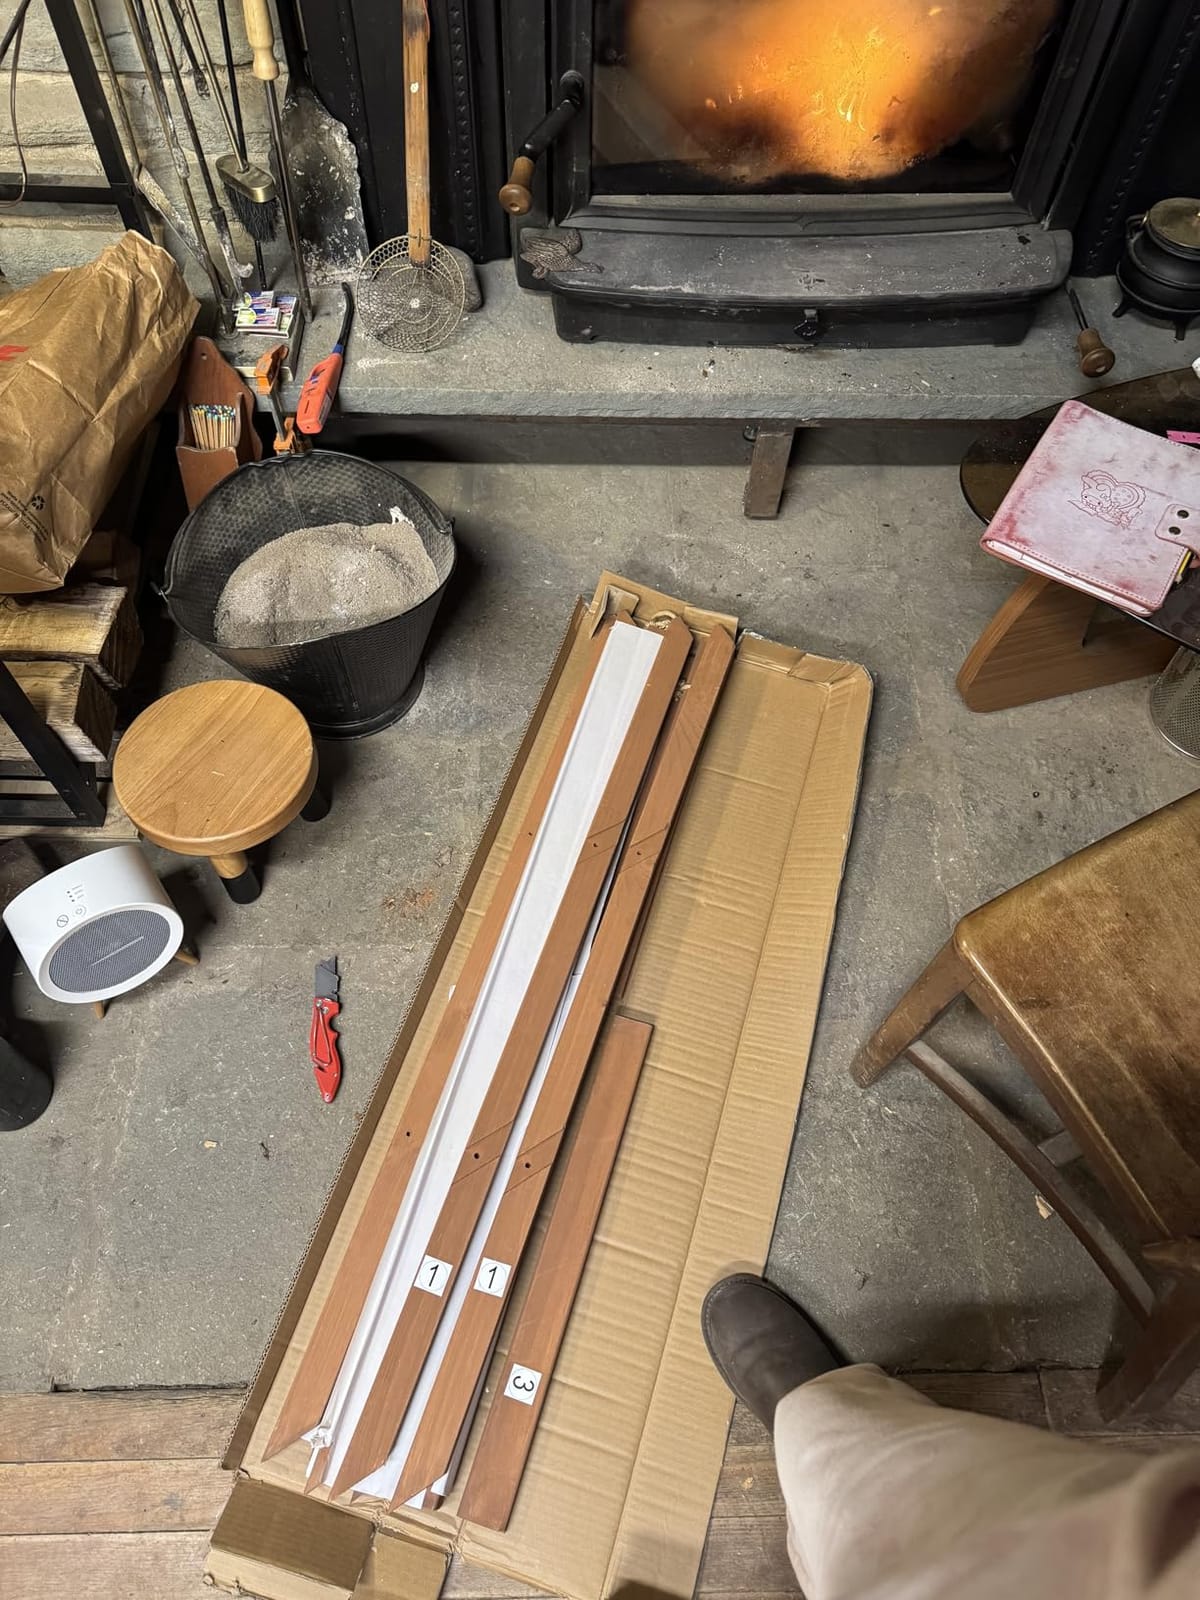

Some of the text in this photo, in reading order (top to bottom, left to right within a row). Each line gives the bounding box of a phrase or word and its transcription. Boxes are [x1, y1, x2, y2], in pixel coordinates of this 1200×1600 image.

[429, 1264, 439, 1287] 1
[488, 1266, 498, 1289] 1
[512, 1375, 534, 1392] 3
